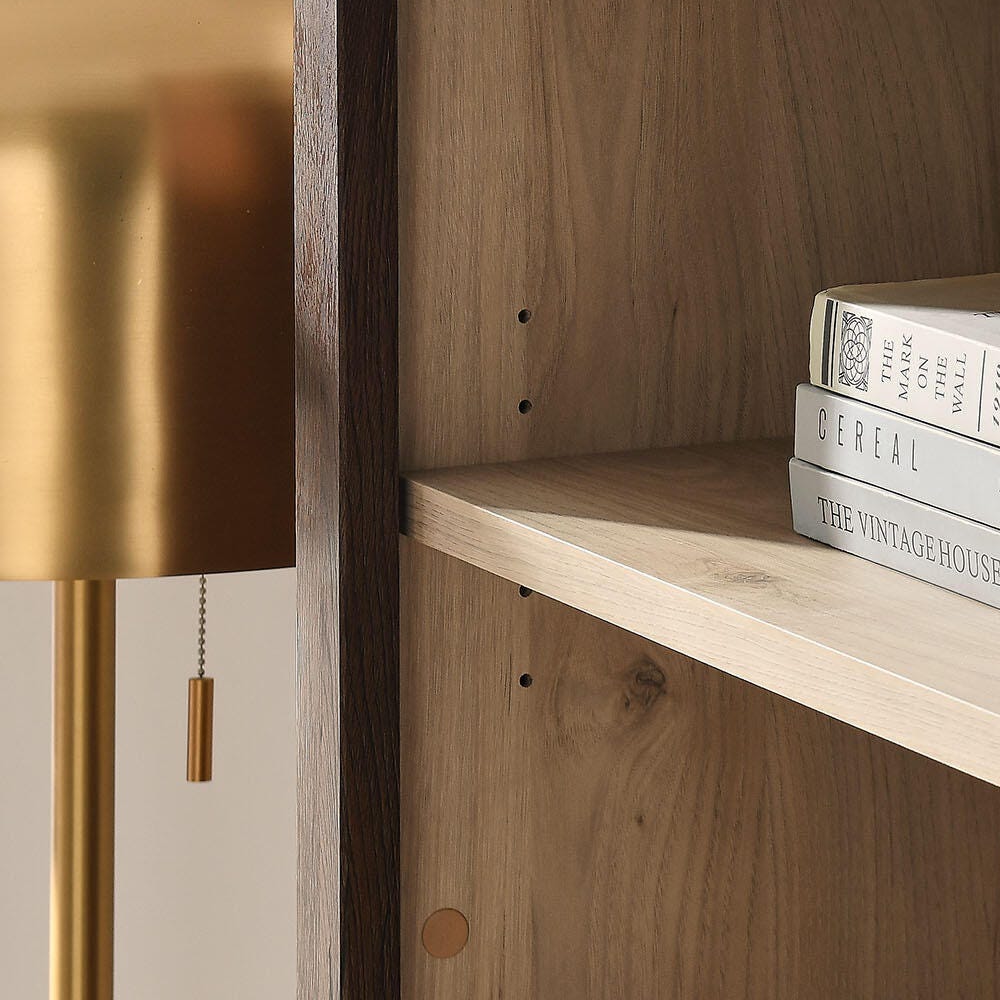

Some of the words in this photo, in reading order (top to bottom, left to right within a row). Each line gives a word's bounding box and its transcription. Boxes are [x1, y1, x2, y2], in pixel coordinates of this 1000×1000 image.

[881, 339, 894, 382] THE
[898, 334, 912, 400] MARK
[917, 355, 928, 389] ON
[935, 356, 947, 399] THE
[952, 353, 966, 414] WALL
[818, 408, 918, 472] CEREAL
[817, 496, 854, 534] THE
[857, 510, 936, 562] VINTAGE
